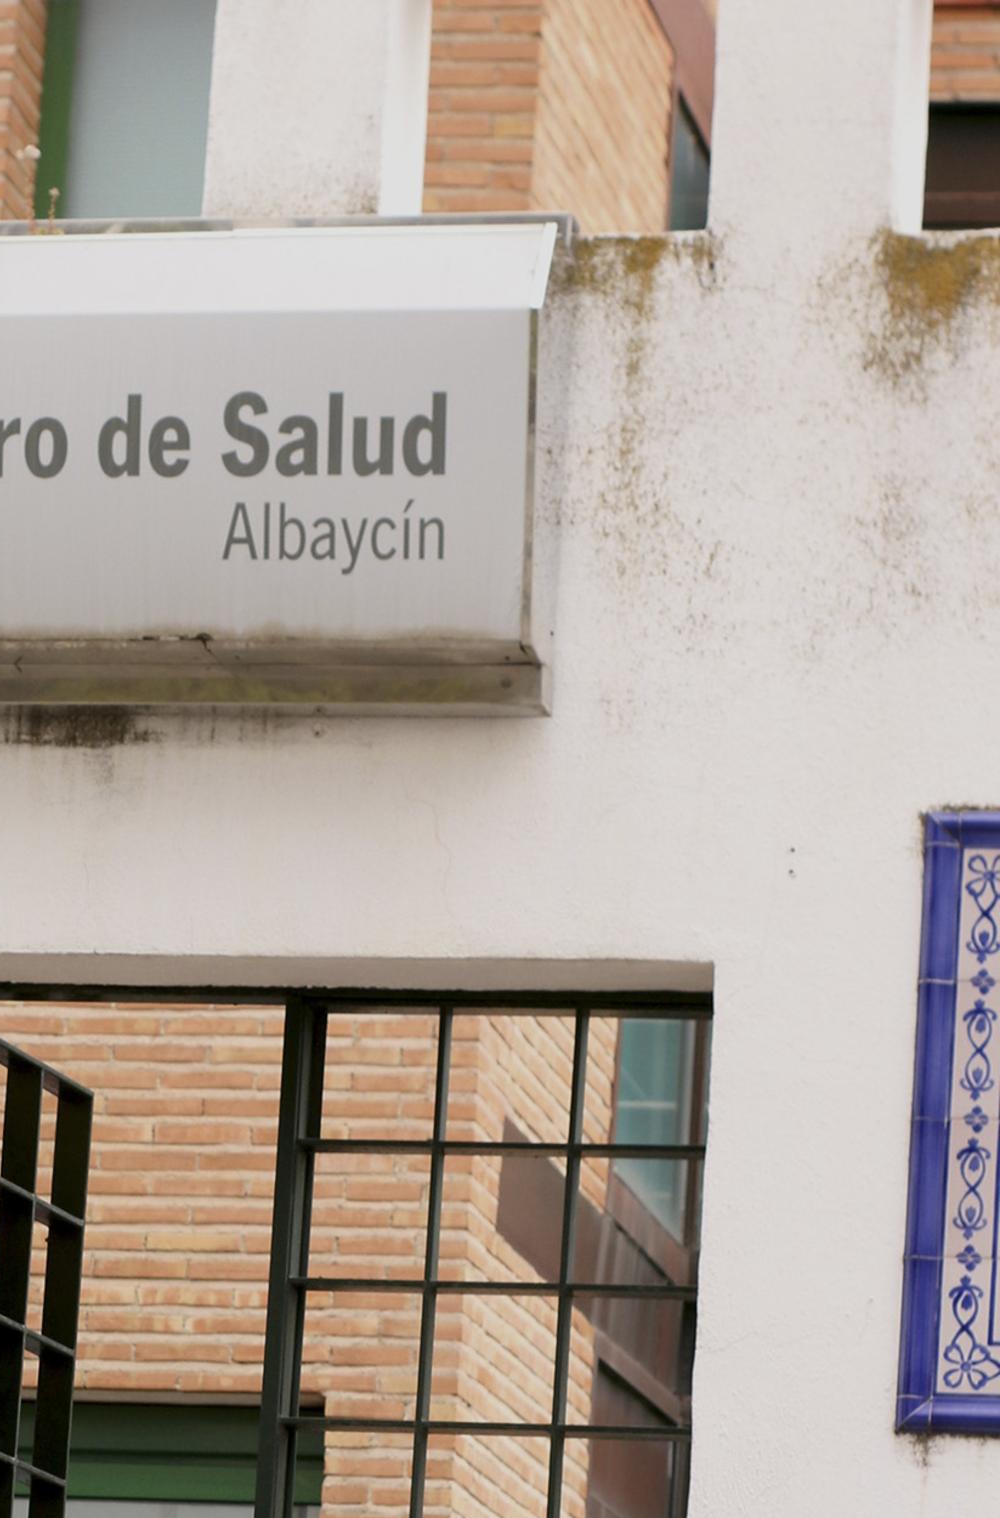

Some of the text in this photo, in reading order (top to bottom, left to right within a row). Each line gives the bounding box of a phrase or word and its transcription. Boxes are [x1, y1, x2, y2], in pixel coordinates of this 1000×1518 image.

[97, 394, 190, 479] de
[220, 391, 447, 477] Salud
[222, 498, 446, 576] Albaycín
